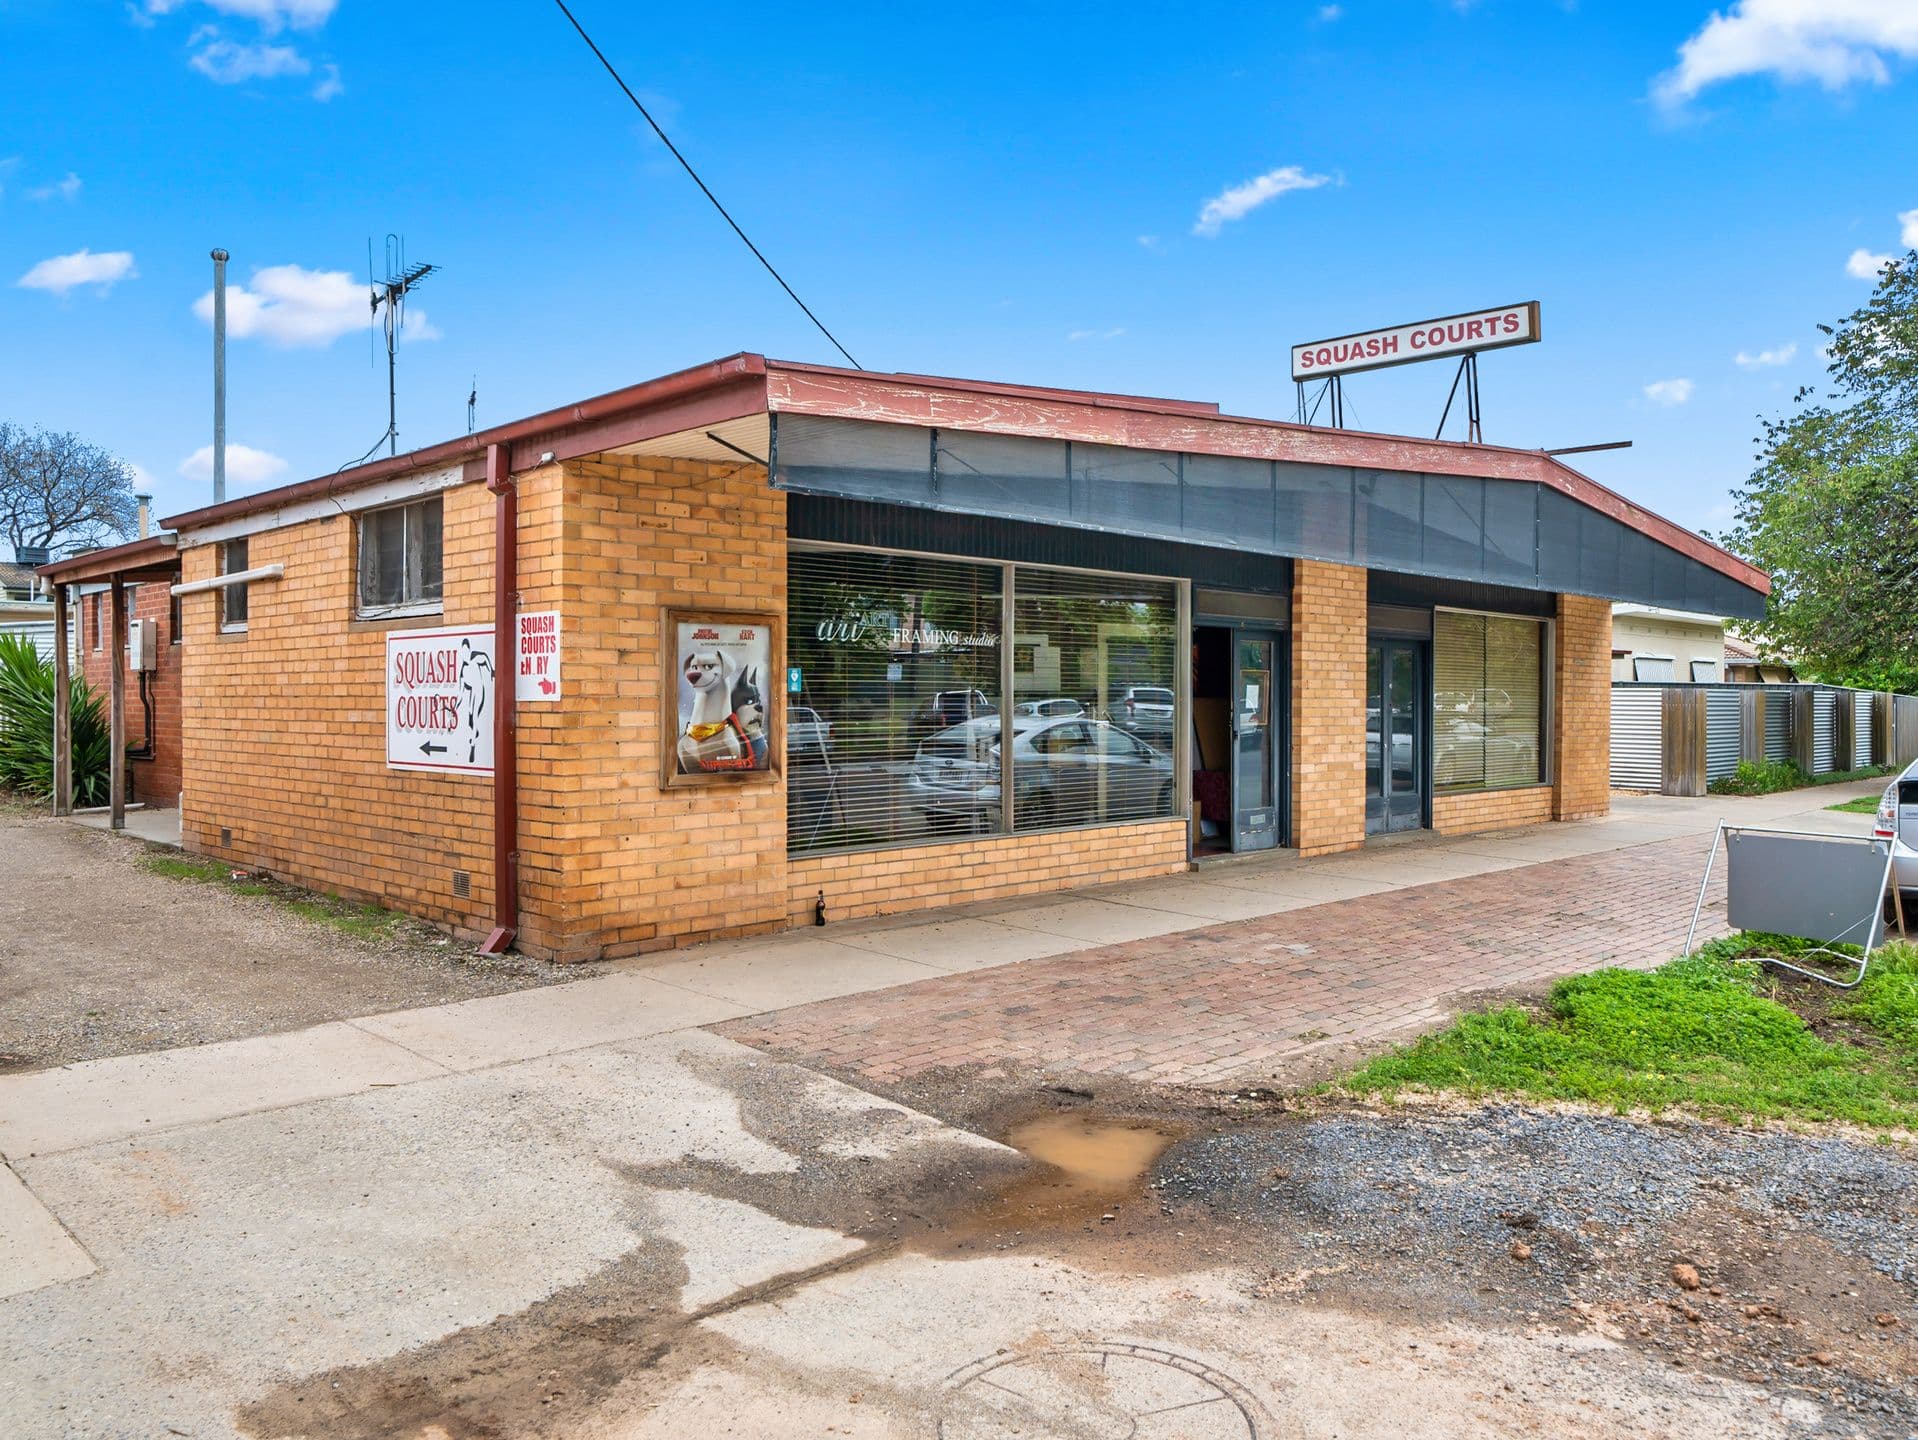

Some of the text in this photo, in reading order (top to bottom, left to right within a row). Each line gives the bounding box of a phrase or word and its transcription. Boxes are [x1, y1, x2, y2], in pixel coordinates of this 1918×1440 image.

[1300, 312, 1520, 369] SQUASH COURTS
[521, 615, 555, 635] SQUASH
[521, 635, 556, 654] COURTS
[893, 627, 959, 646] FRAMING
[395, 649, 458, 690] SQUASH
[520, 655, 549, 675] ENRY
[396, 695, 459, 730] COURTS
